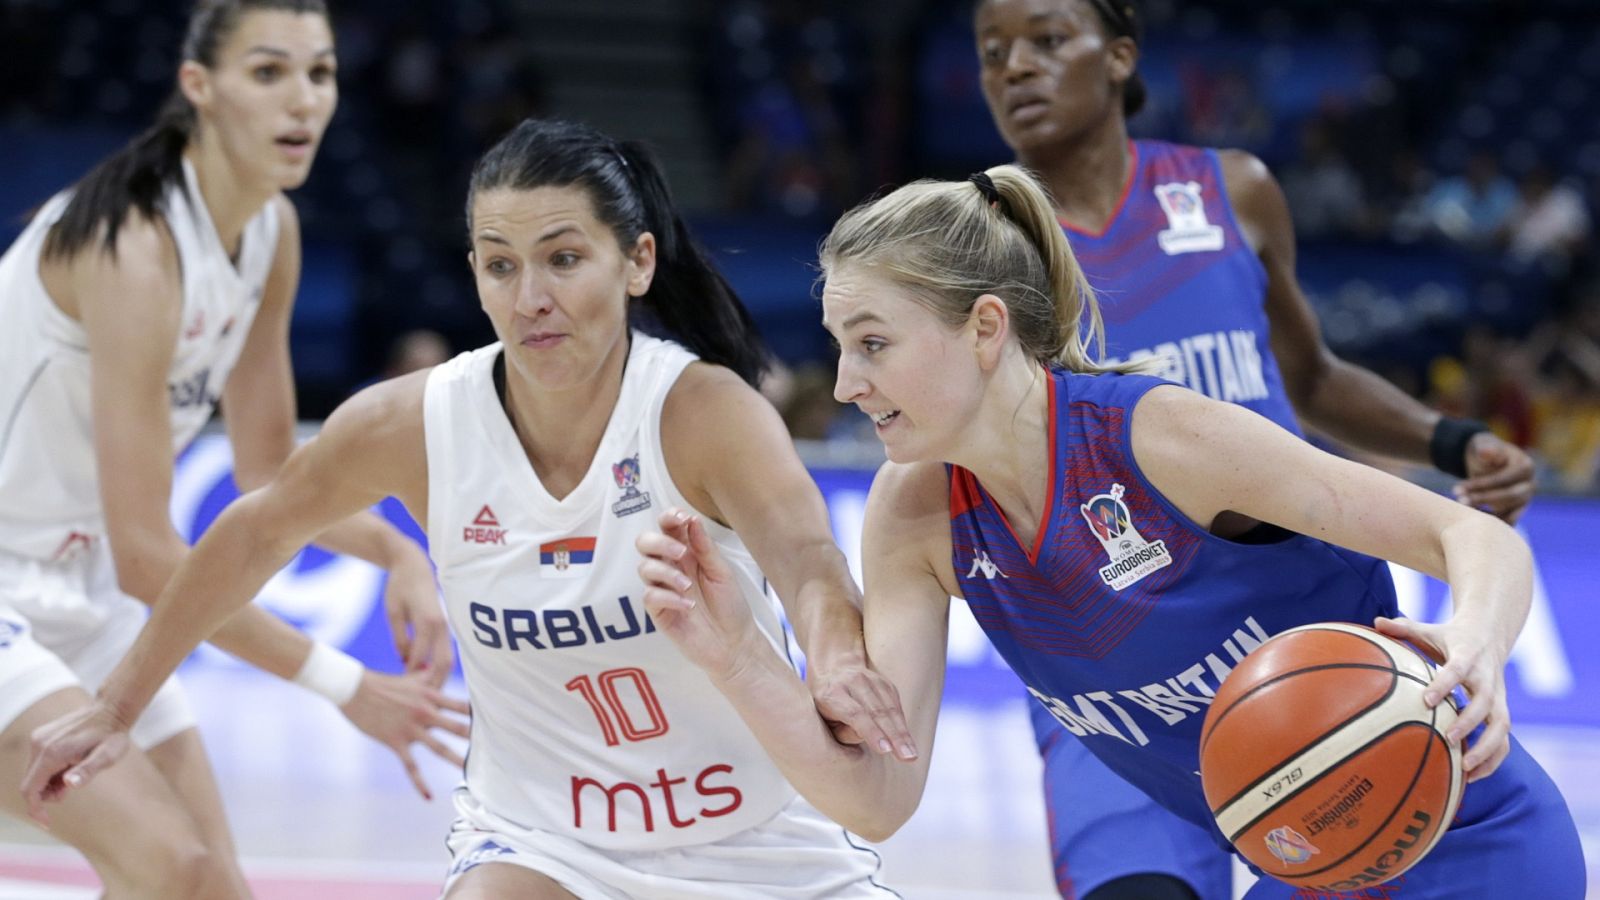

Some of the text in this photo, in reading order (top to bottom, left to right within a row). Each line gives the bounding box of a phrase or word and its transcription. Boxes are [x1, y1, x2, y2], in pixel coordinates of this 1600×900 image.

[463, 527, 509, 546] PEAK
[1102, 542, 1166, 582] EUROBASKET
[565, 667, 670, 747] 10
[571, 764, 743, 832] mts
[1262, 767, 1303, 802] GL6X
[1306, 778, 1374, 836] EUROBASKET
